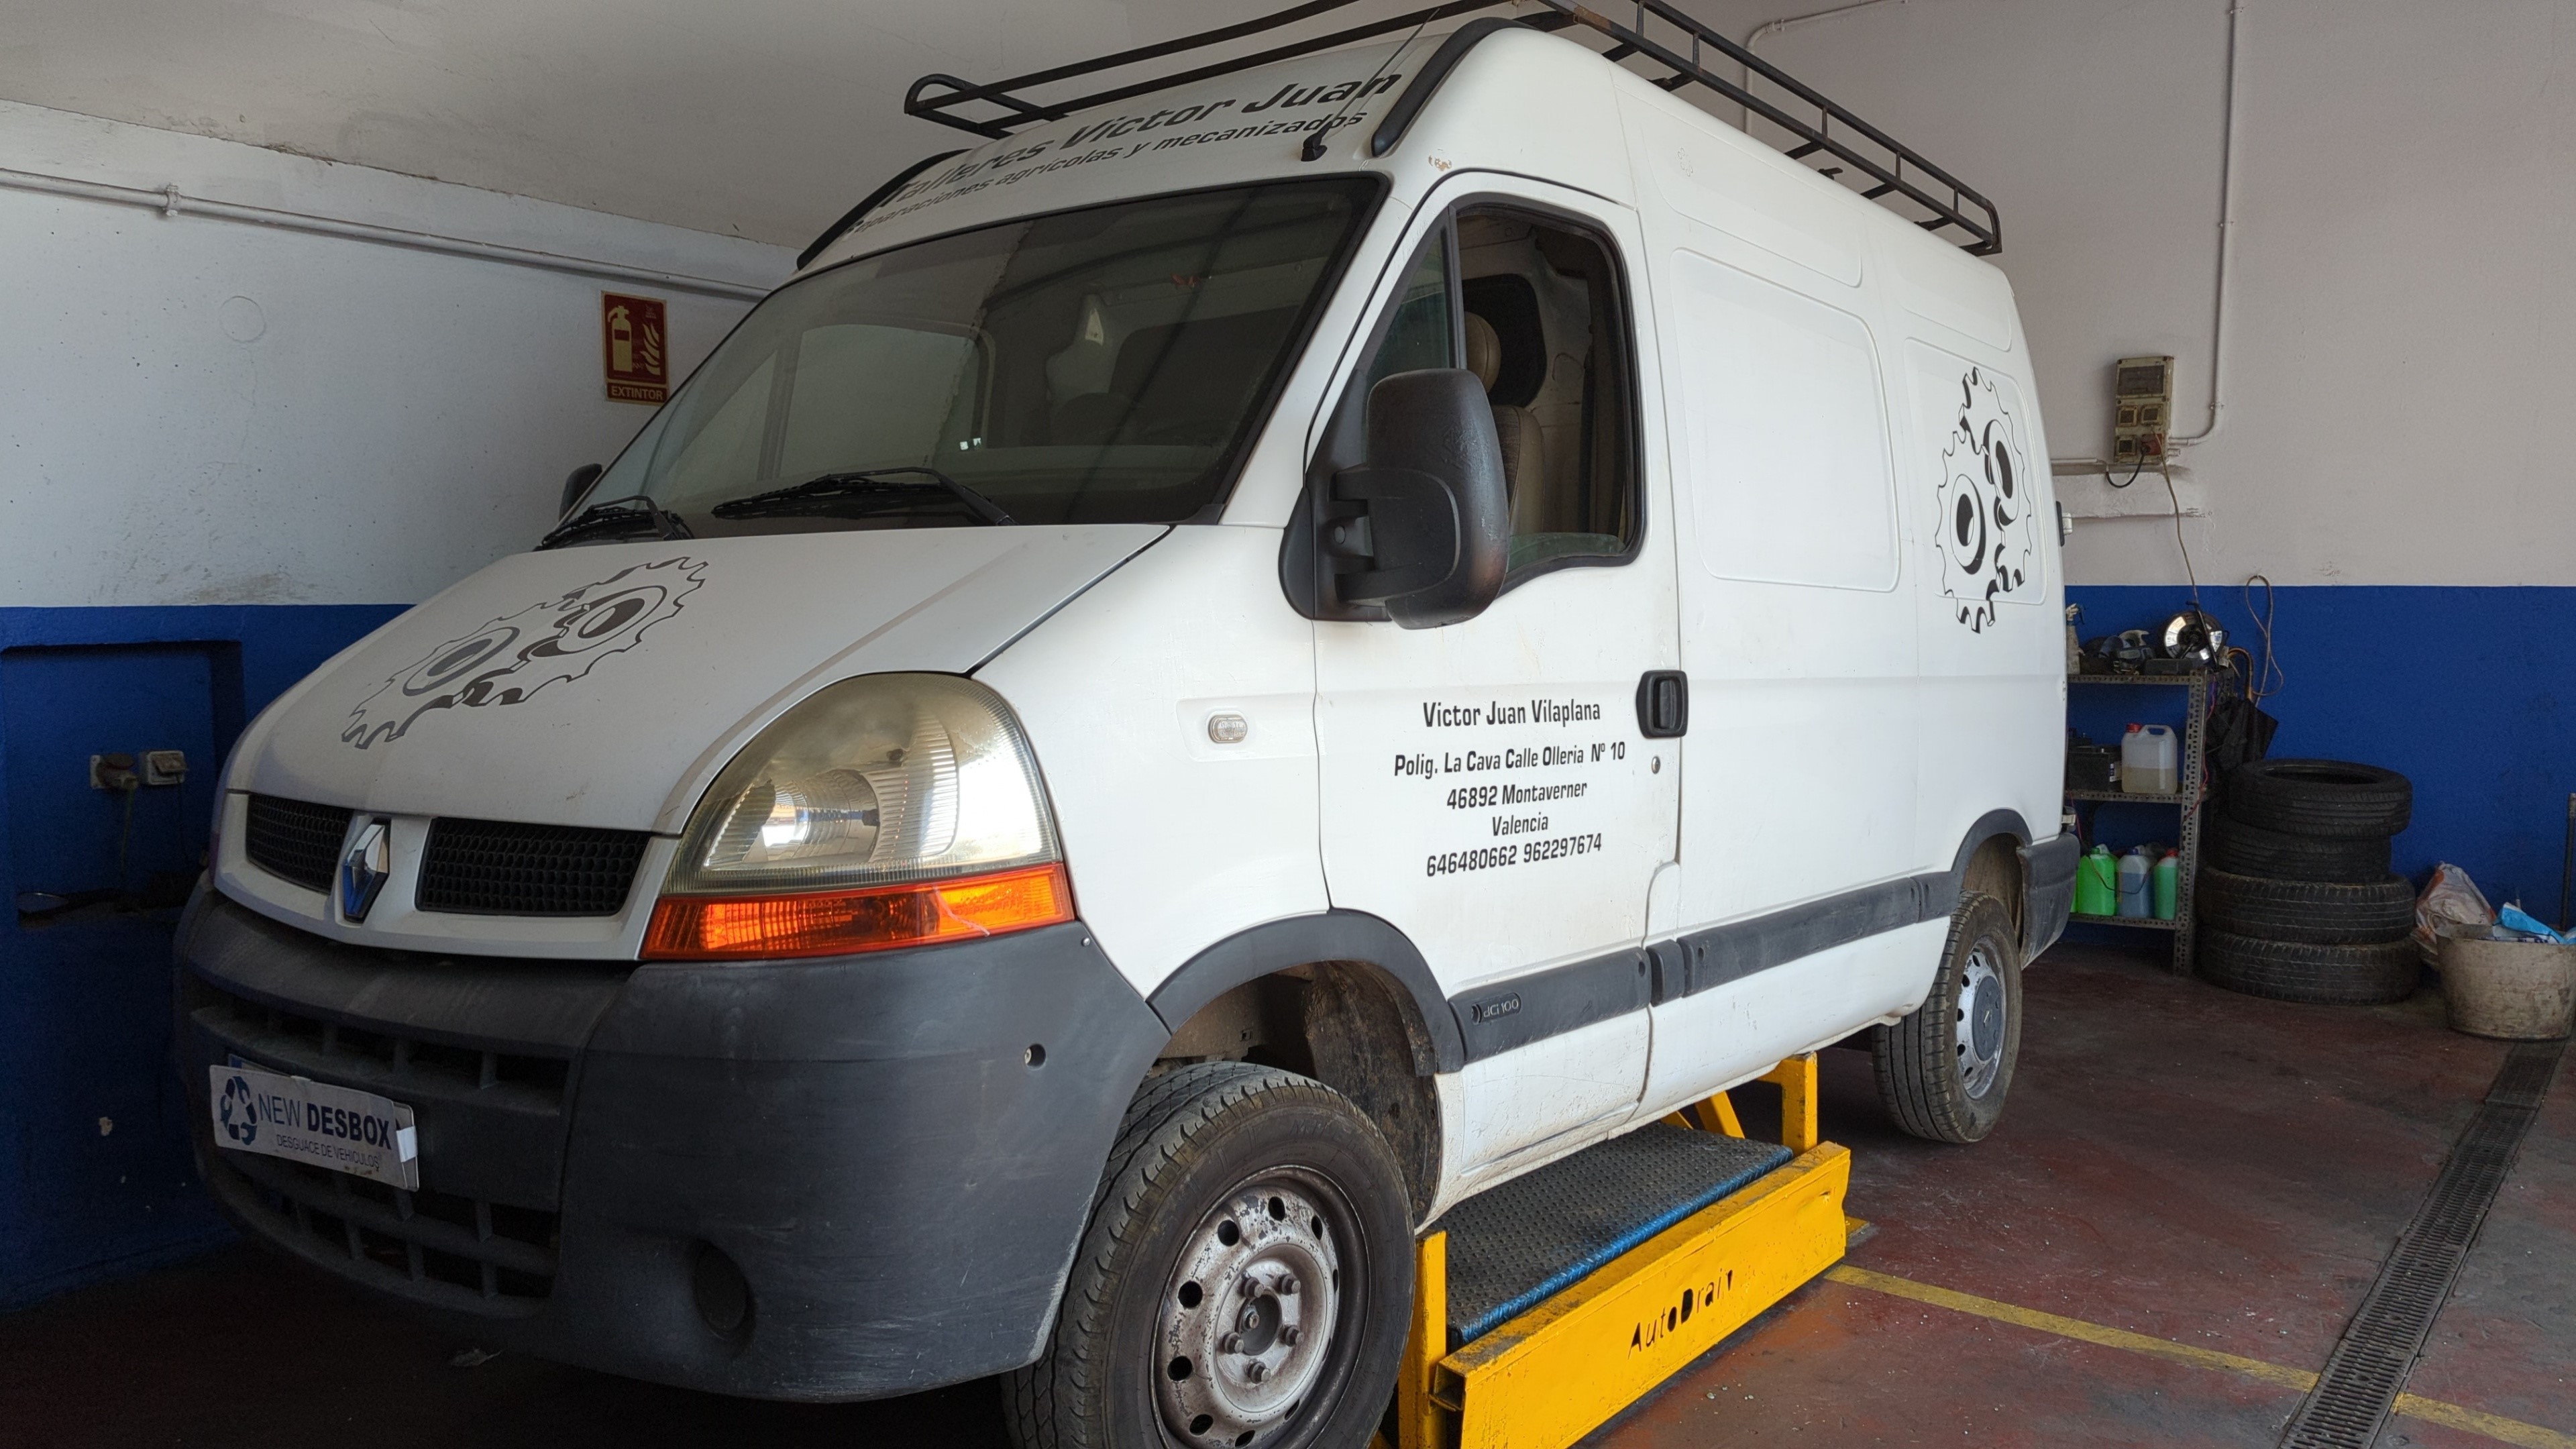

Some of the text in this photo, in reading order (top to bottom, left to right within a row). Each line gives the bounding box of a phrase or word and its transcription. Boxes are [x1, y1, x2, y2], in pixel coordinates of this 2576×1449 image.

[1059, 99, 1236, 150] Victor
[1241, 74, 1402, 113] Juan
[996, 147, 1124, 184] agricolas
[1123, 142, 1151, 158] y
[1152, 113, 1367, 150] mecanizados
[611, 386, 663, 400] EXTINTOR
[1423, 698, 1601, 727] Victor Juan Vilaplana
[1395, 753, 1438, 780] Polig.
[1444, 752, 1462, 773] La
[1466, 751, 1501, 771] Cava
[1505, 747, 1538, 769] Calle
[1543, 745, 1584, 766] Olleria
[1611, 741, 1625, 760] 10
[1447, 782, 1587, 810] 46892 Montaverner
[1492, 812, 1548, 837] Valencia
[1427, 833, 1602, 877] 646480662 962297674
[1501, 998, 1519, 1014] 100
[258, 1093, 392, 1150] NEW DESBOX
[276, 1134, 320, 1155] DESGUACE
[321, 1143, 333, 1158] DE
